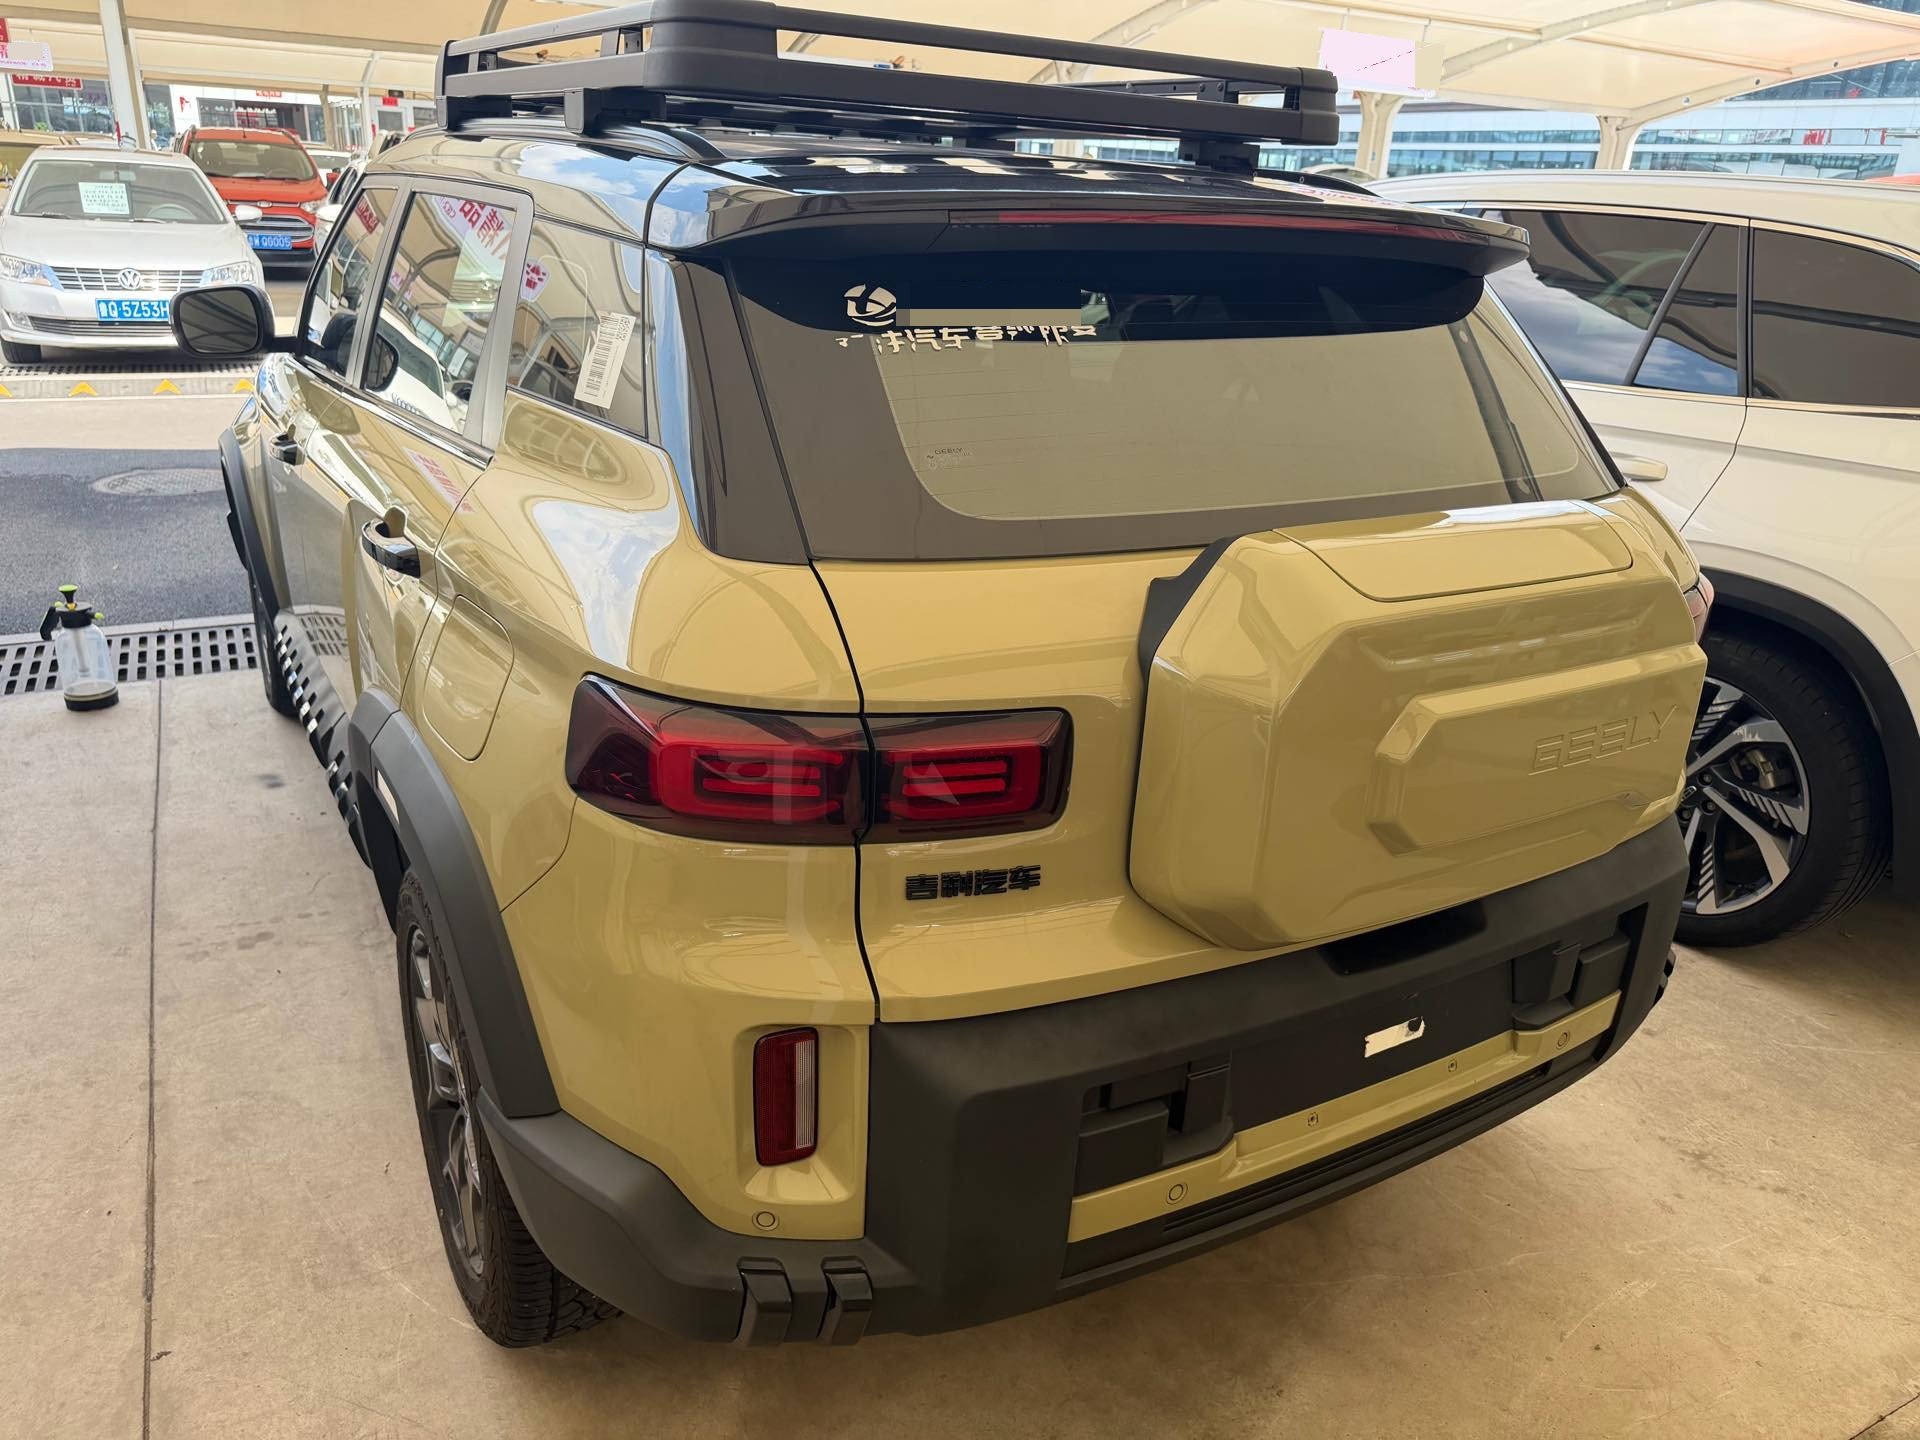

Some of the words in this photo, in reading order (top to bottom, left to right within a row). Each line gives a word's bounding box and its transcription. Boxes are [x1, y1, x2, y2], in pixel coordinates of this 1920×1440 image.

[1528, 704, 1678, 776] GEELY
[905, 865, 1042, 900] 吉利汽车
